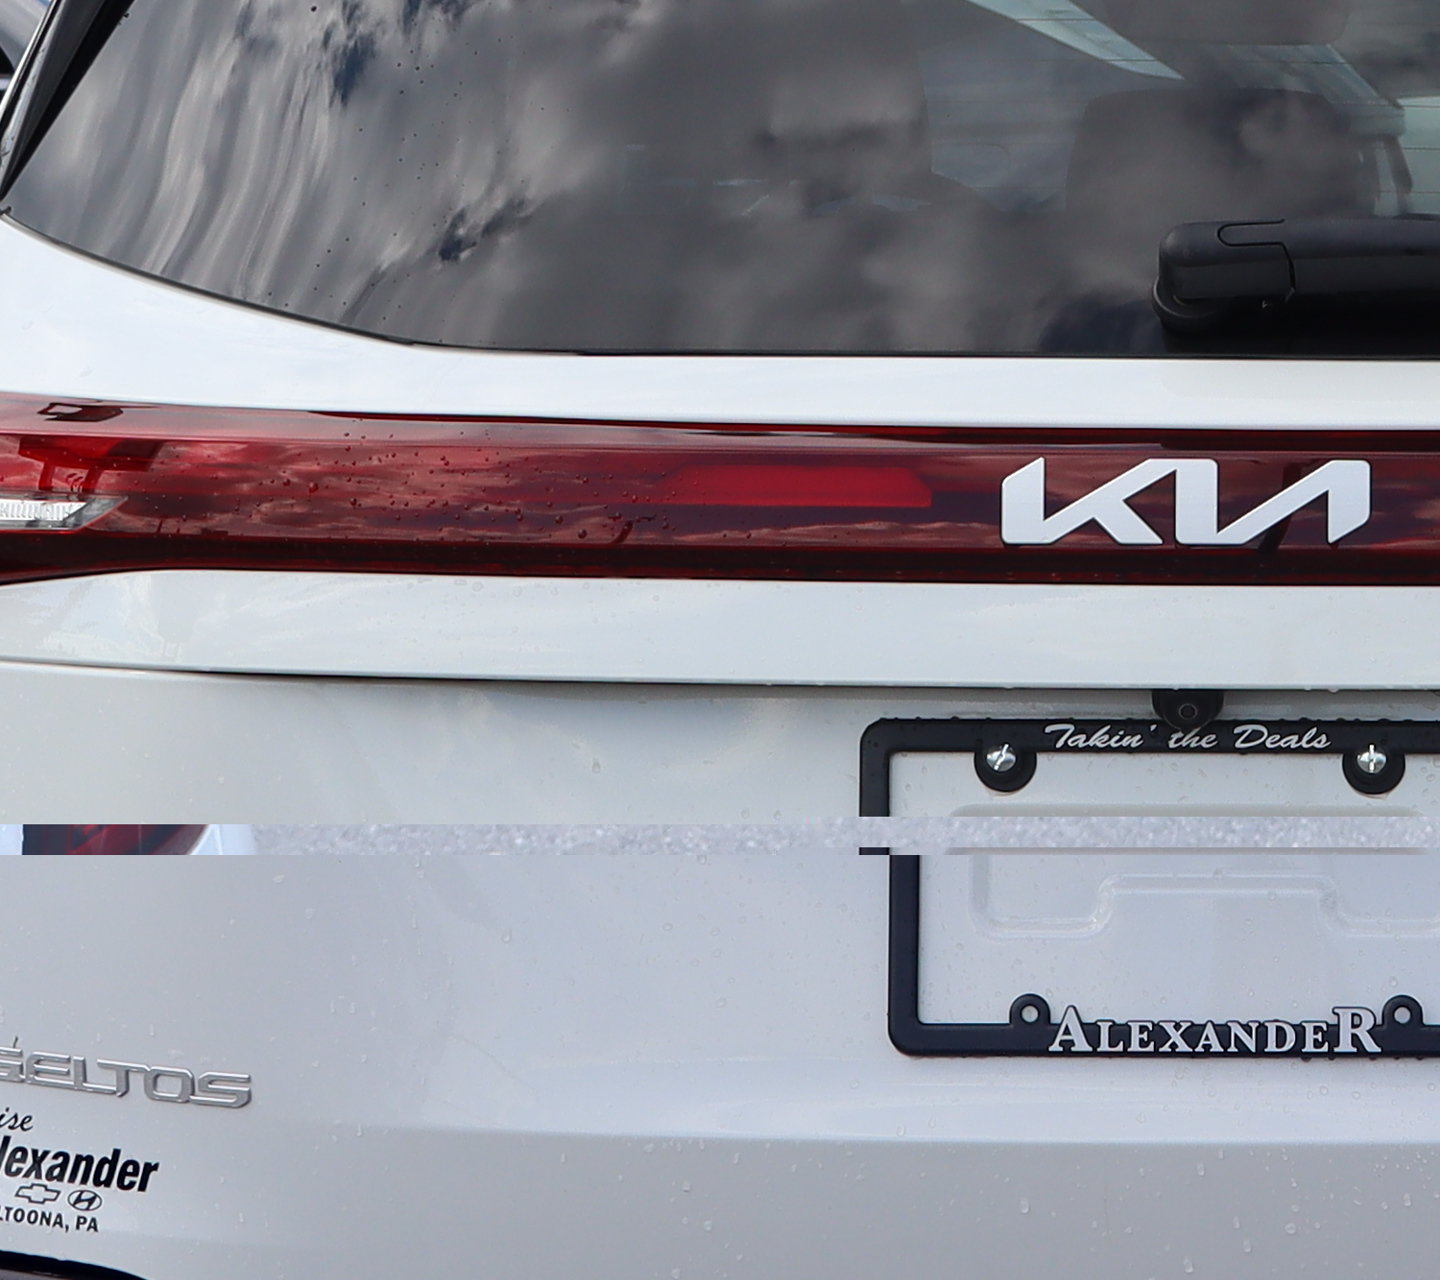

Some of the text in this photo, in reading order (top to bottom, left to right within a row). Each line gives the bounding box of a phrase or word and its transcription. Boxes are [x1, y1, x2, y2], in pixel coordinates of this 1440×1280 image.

[1001, 457, 1372, 545] KIA
[1044, 723, 1332, 749] Takin' the Deals
[1048, 1004, 1383, 1054] ALEXANDER
[76, 1214, 100, 1233] PA
